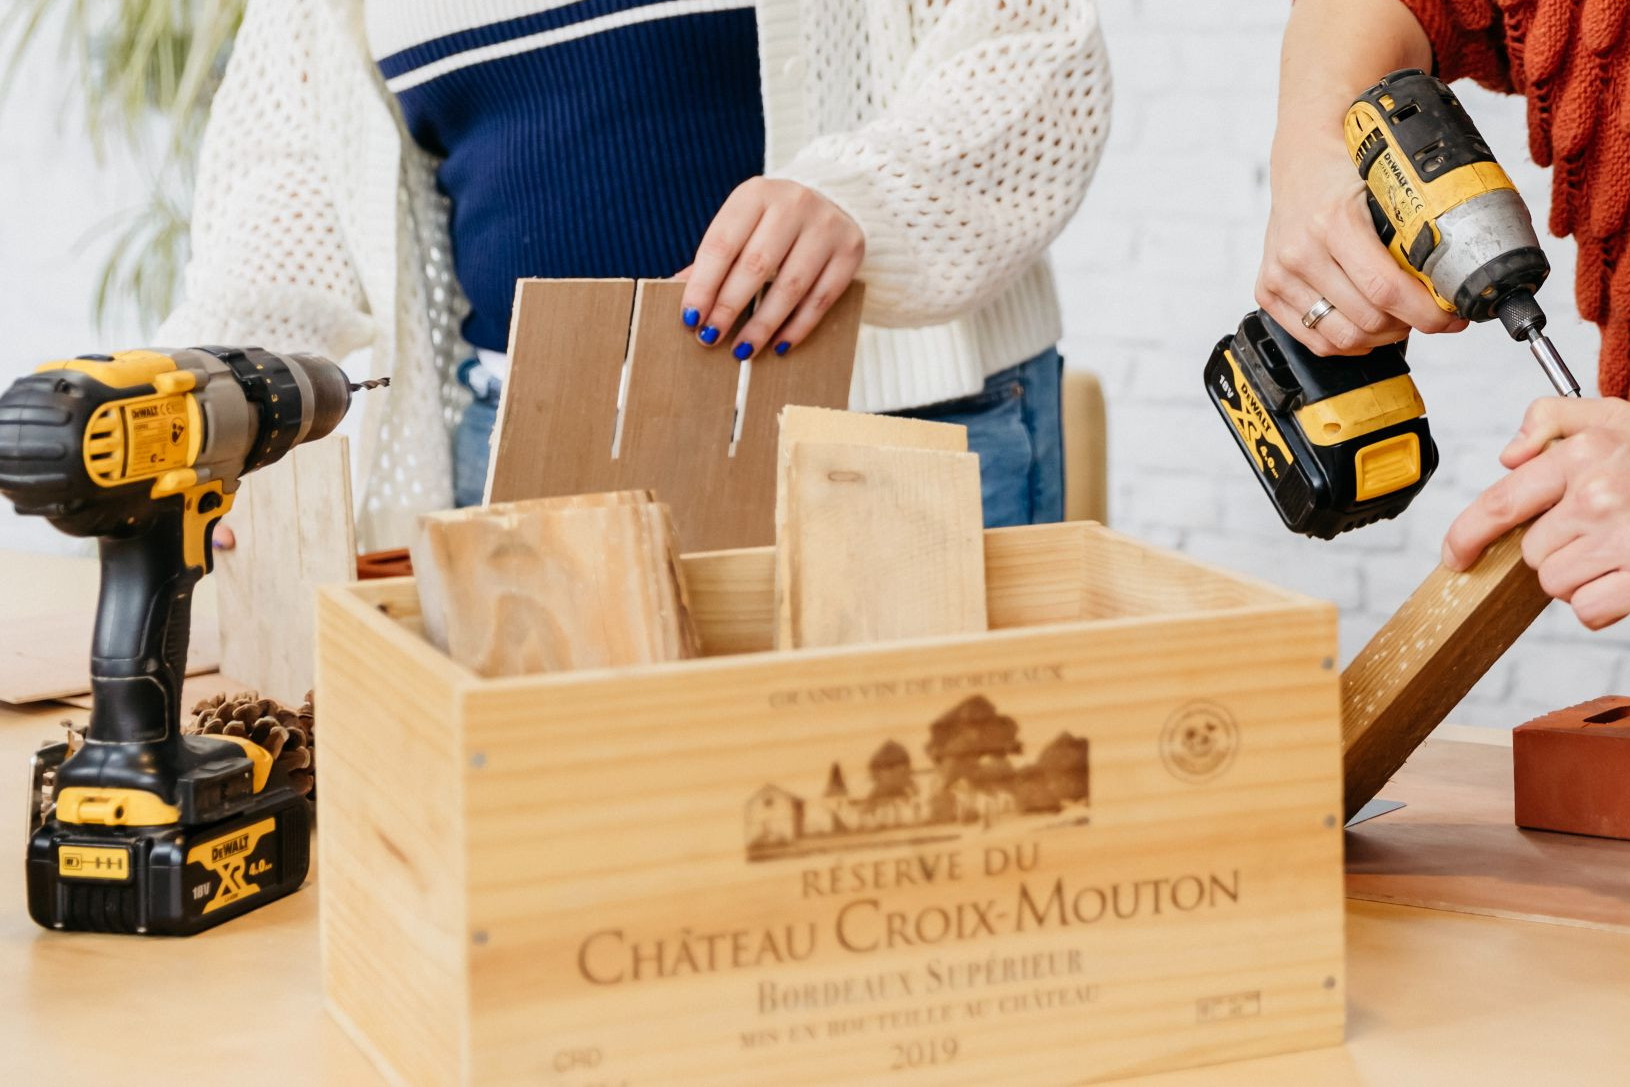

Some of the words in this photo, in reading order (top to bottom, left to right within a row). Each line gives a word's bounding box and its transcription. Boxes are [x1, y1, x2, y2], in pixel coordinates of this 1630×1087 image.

[1219, 374, 1235, 399] 18V
[769, 684, 852, 709] GRAND
[858, 679, 898, 700] VIN
[904, 675, 934, 695] DE
[941, 663, 1066, 690] BORDEAUX
[802, 849, 962, 899] RÉSERVE
[983, 842, 1041, 878] DU
[192, 881, 211, 900] 18V
[788, 1022, 818, 1043] EN
[890, 1037, 960, 1072] 2019
